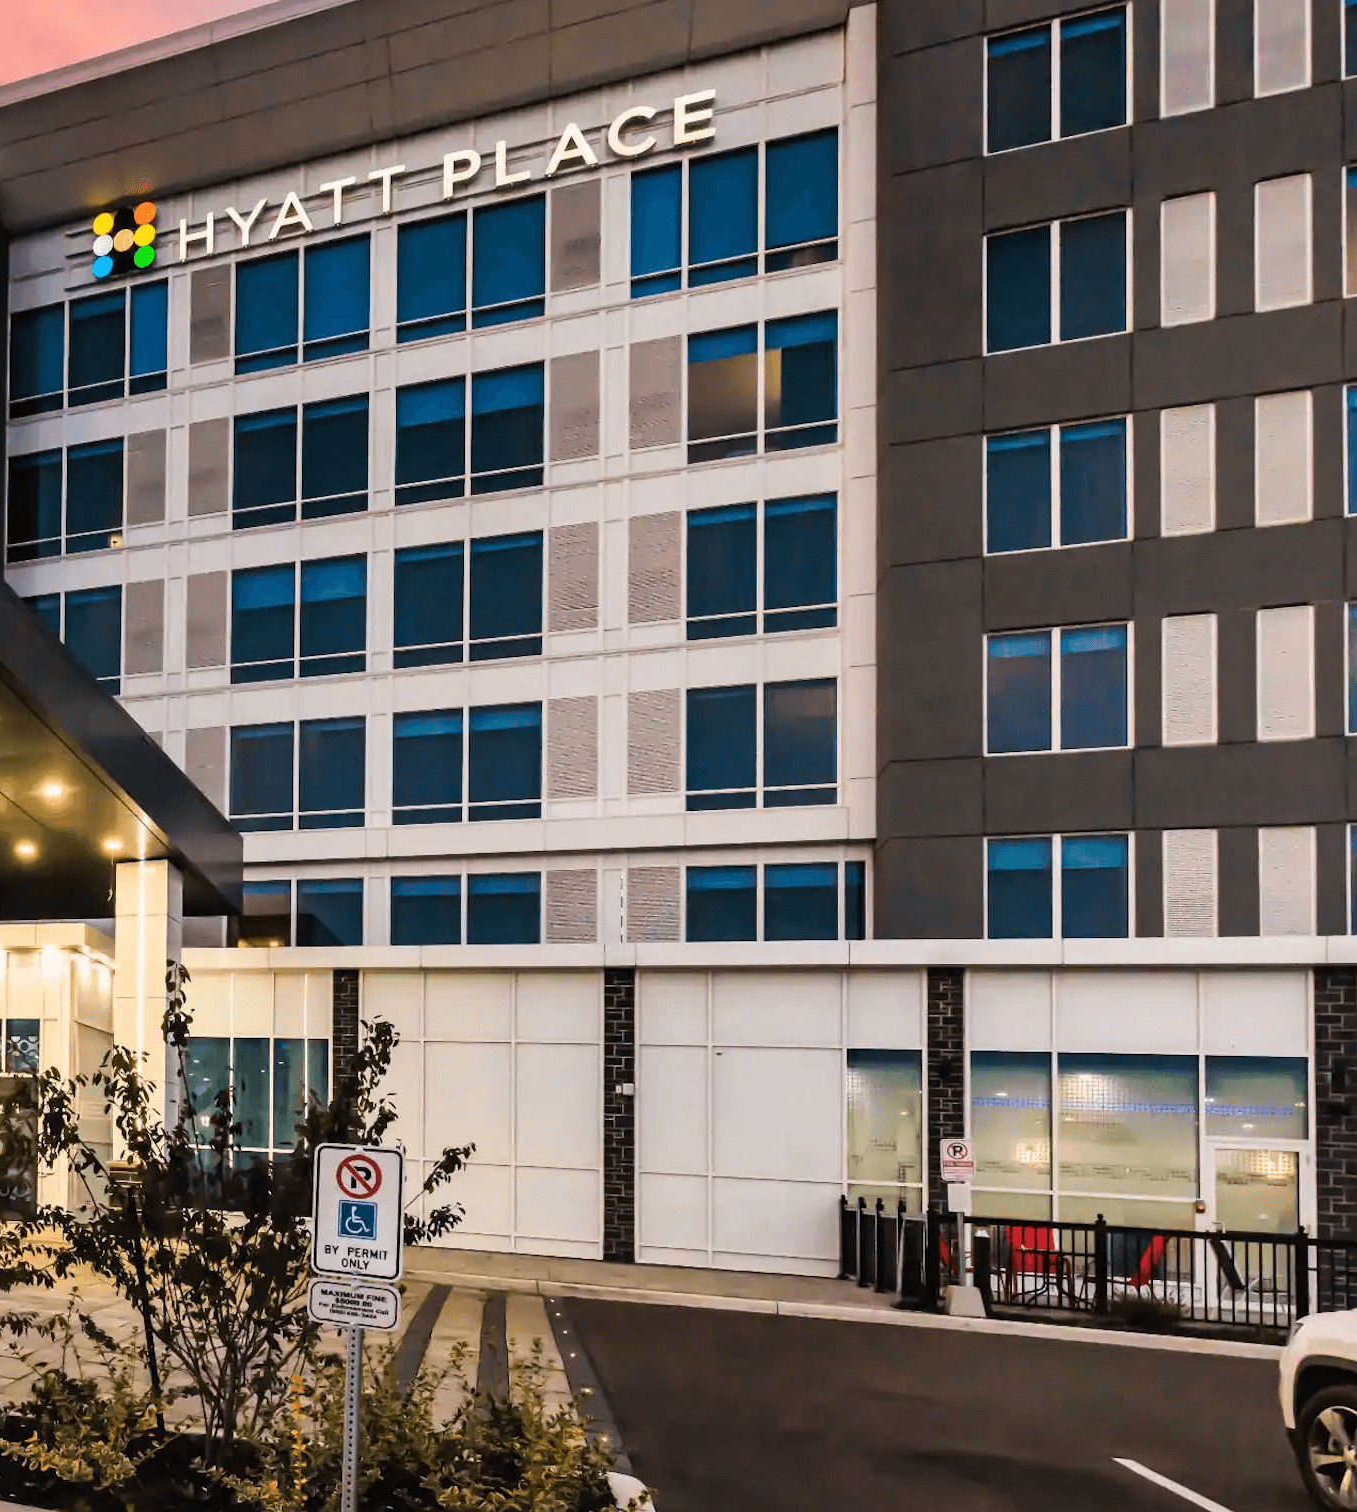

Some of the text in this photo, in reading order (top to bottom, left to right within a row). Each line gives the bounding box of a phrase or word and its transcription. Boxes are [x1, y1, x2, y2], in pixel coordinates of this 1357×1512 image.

[178, 88, 716, 262] HYATT PLACE
[324, 1244, 389, 1261] BY PERMIT
[341, 1257, 370, 1271] ONLY
[320, 1288, 388, 1303] MAXIMUM FINE
